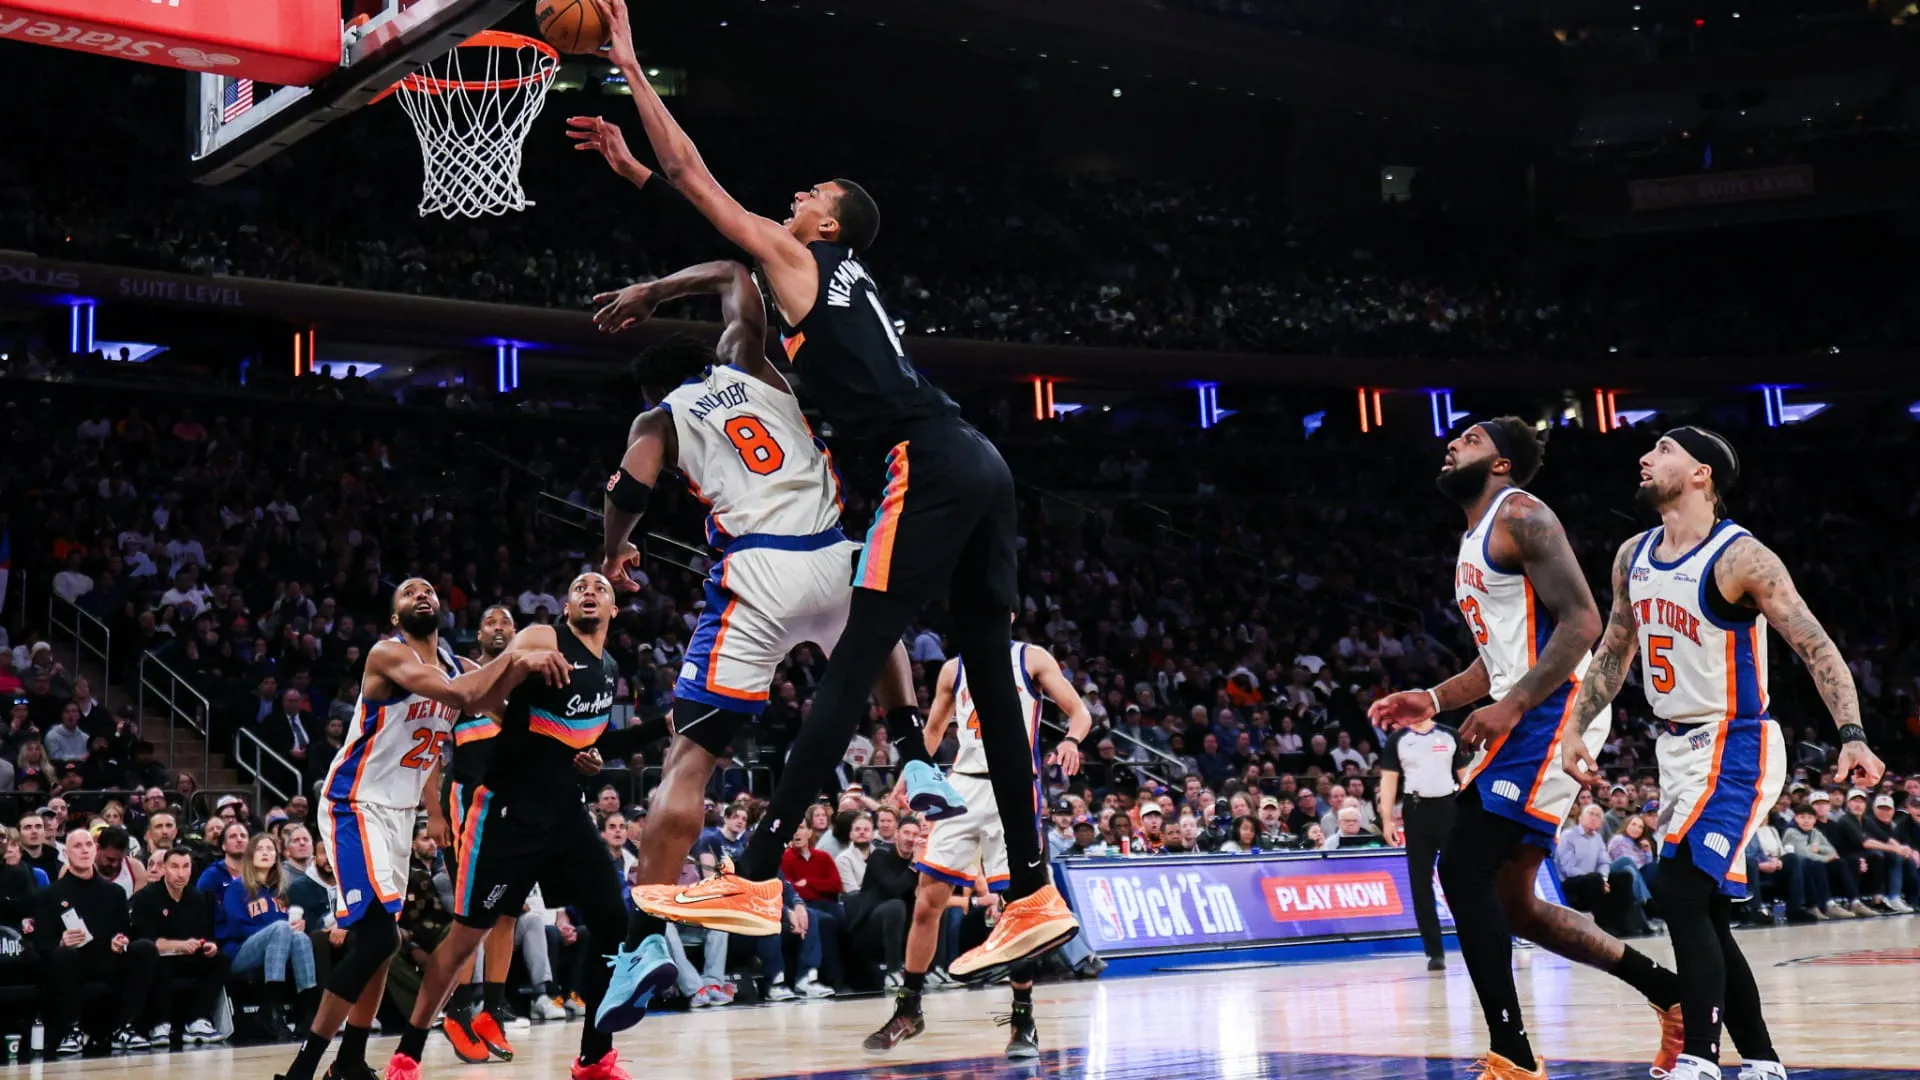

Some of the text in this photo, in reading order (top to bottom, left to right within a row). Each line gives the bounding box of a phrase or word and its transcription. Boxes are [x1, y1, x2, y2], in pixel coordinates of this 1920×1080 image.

[119, 276, 177, 300] SUITE
[184, 283, 244, 307] LEVEL
[723, 415, 785, 477] 8
[1655, 597, 1702, 647] YORK
[1647, 633, 1676, 694] 5
[565, 693, 591, 717] San
[399, 726, 448, 771] 25
[1112, 872, 1244, 937] Pick'Em
[1274, 882, 1388, 912] PLAY NOW
